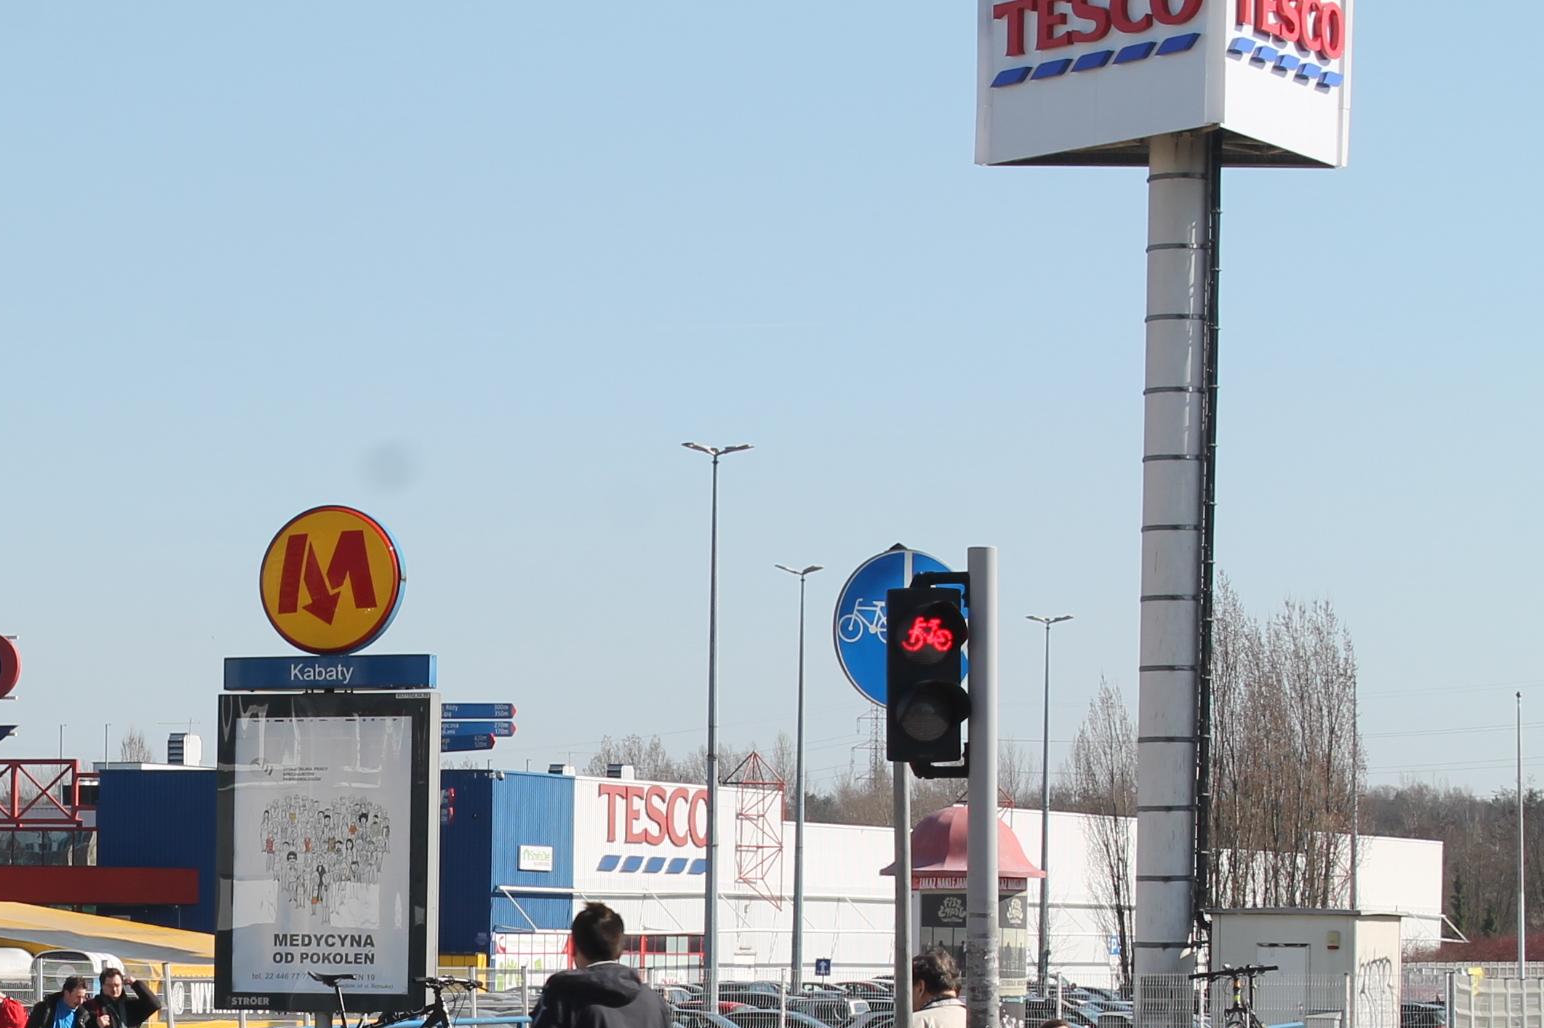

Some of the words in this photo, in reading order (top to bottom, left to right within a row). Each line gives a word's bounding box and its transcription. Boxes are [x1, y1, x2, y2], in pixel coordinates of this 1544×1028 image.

[290, 663, 354, 683] Kabaty
[598, 783, 709, 849] TESCO
[273, 933, 375, 948] MEDYCYNA
[272, 951, 294, 964] OD
[300, 949, 375, 965] POKOLEŃ
